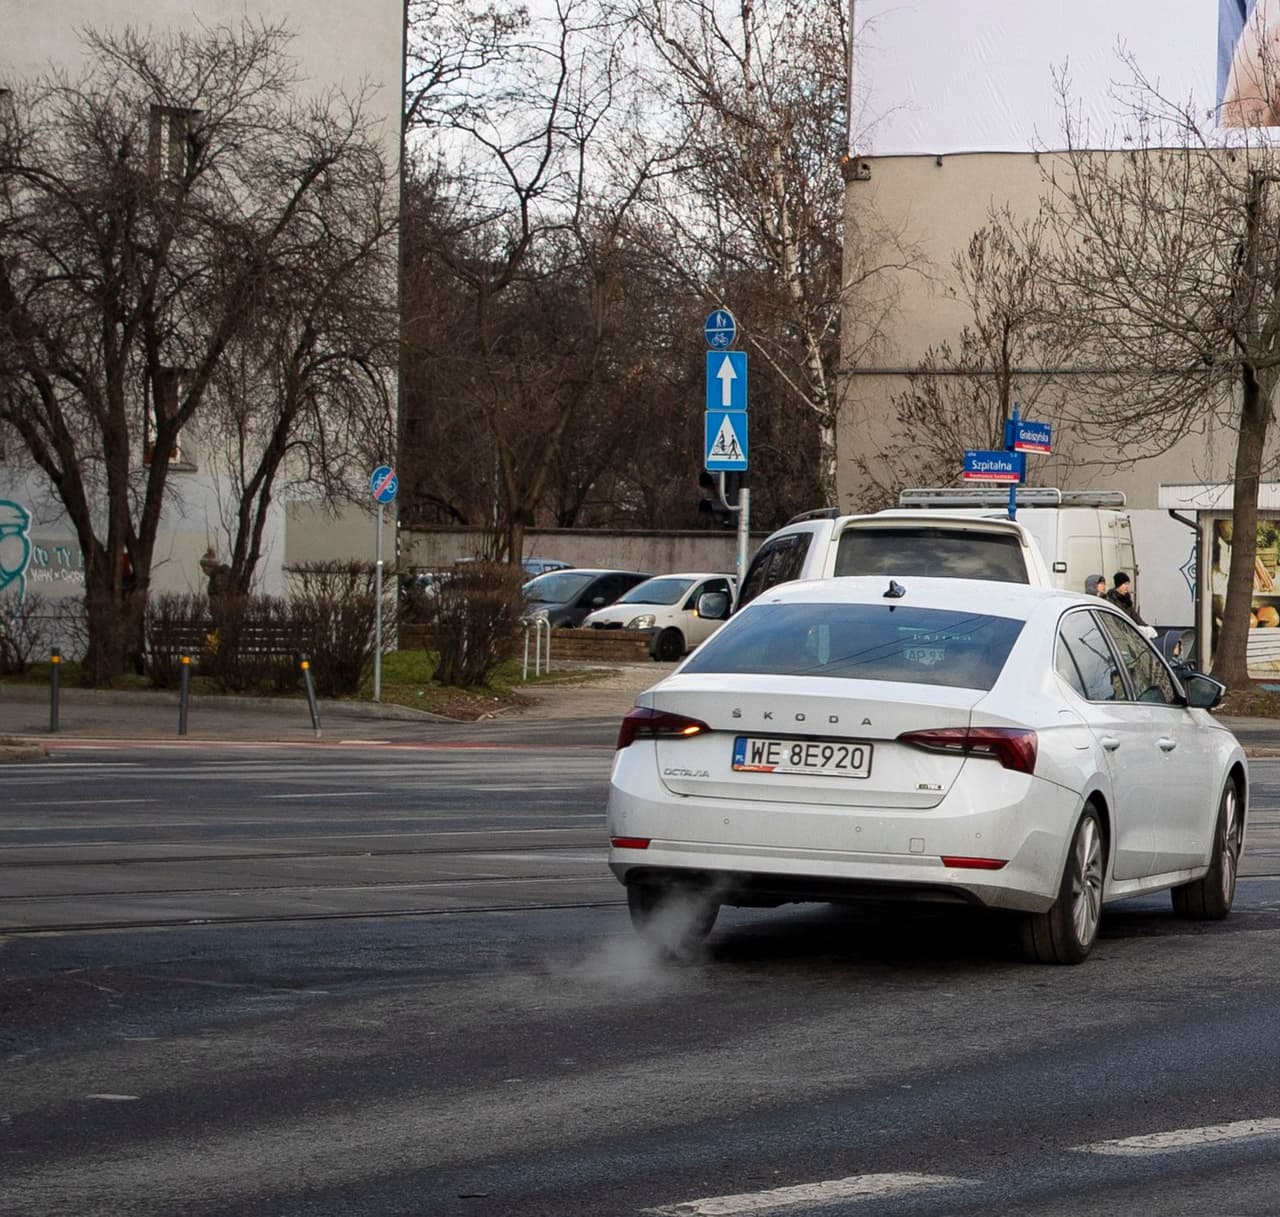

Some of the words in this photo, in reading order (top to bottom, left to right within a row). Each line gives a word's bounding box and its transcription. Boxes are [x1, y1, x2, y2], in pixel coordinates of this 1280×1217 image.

[971, 459, 1013, 472] Szpitalna
[732, 708, 873, 727] ŠKODA
[751, 741, 782, 766] WE
[789, 743, 865, 770] 8E920
